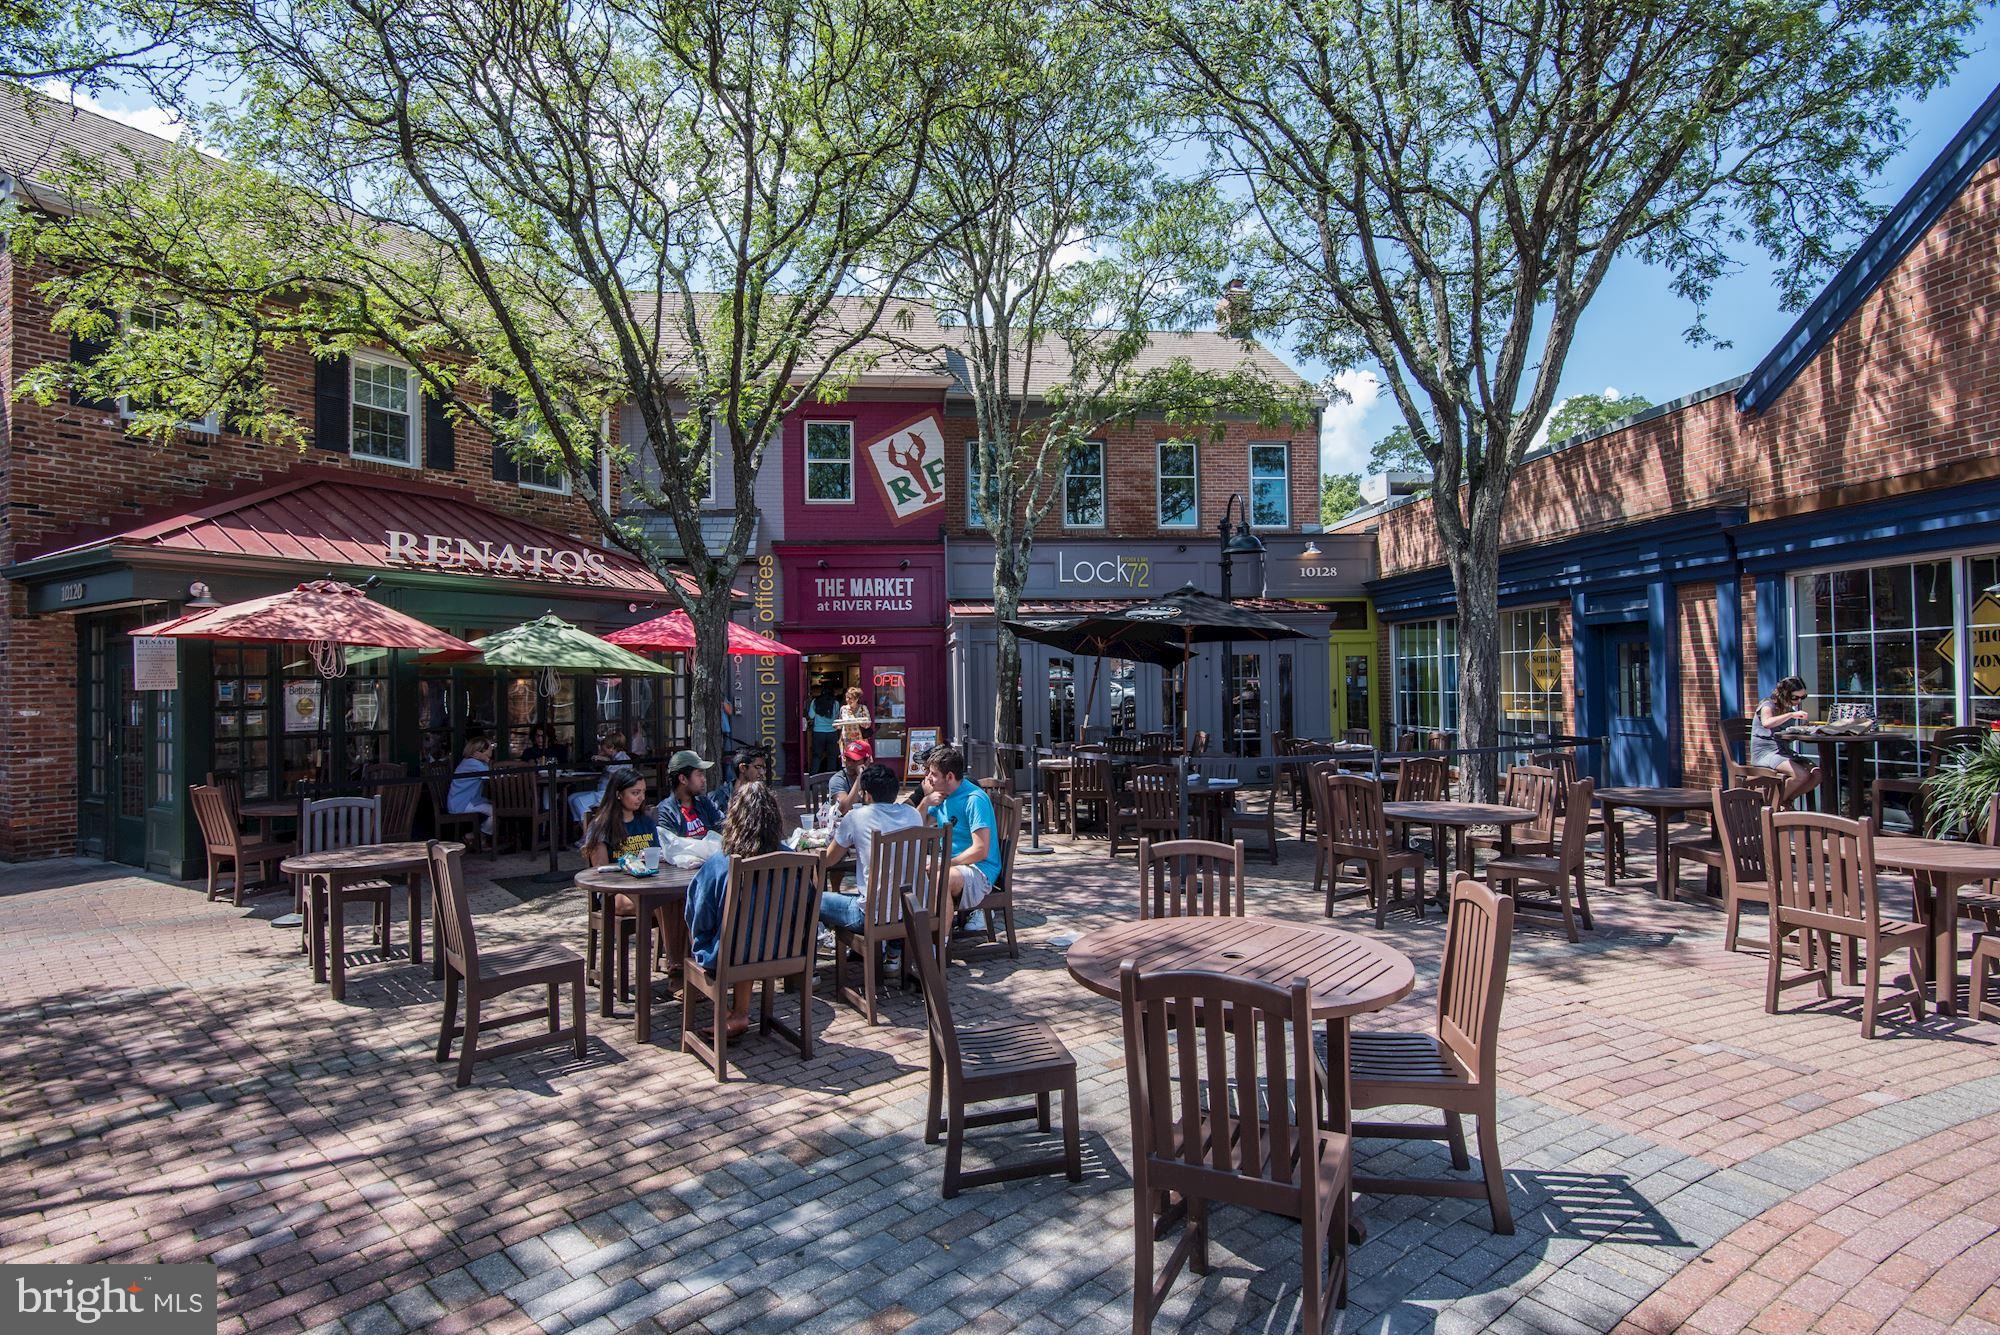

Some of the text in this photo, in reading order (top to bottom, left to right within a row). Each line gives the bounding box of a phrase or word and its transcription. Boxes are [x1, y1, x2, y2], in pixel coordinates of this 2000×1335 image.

[887, 476, 921, 505] R
[385, 530, 605, 578] RENATO'S
[1300, 567, 1337, 577] 10128
[61, 583, 83, 601] 10120
[755, 554, 774, 622] offices
[815, 578, 914, 597] THE MARKET
[817, 600, 913, 611] at RIVER FALLS
[841, 635, 876, 645] 10124
[756, 629, 780, 685] plae
